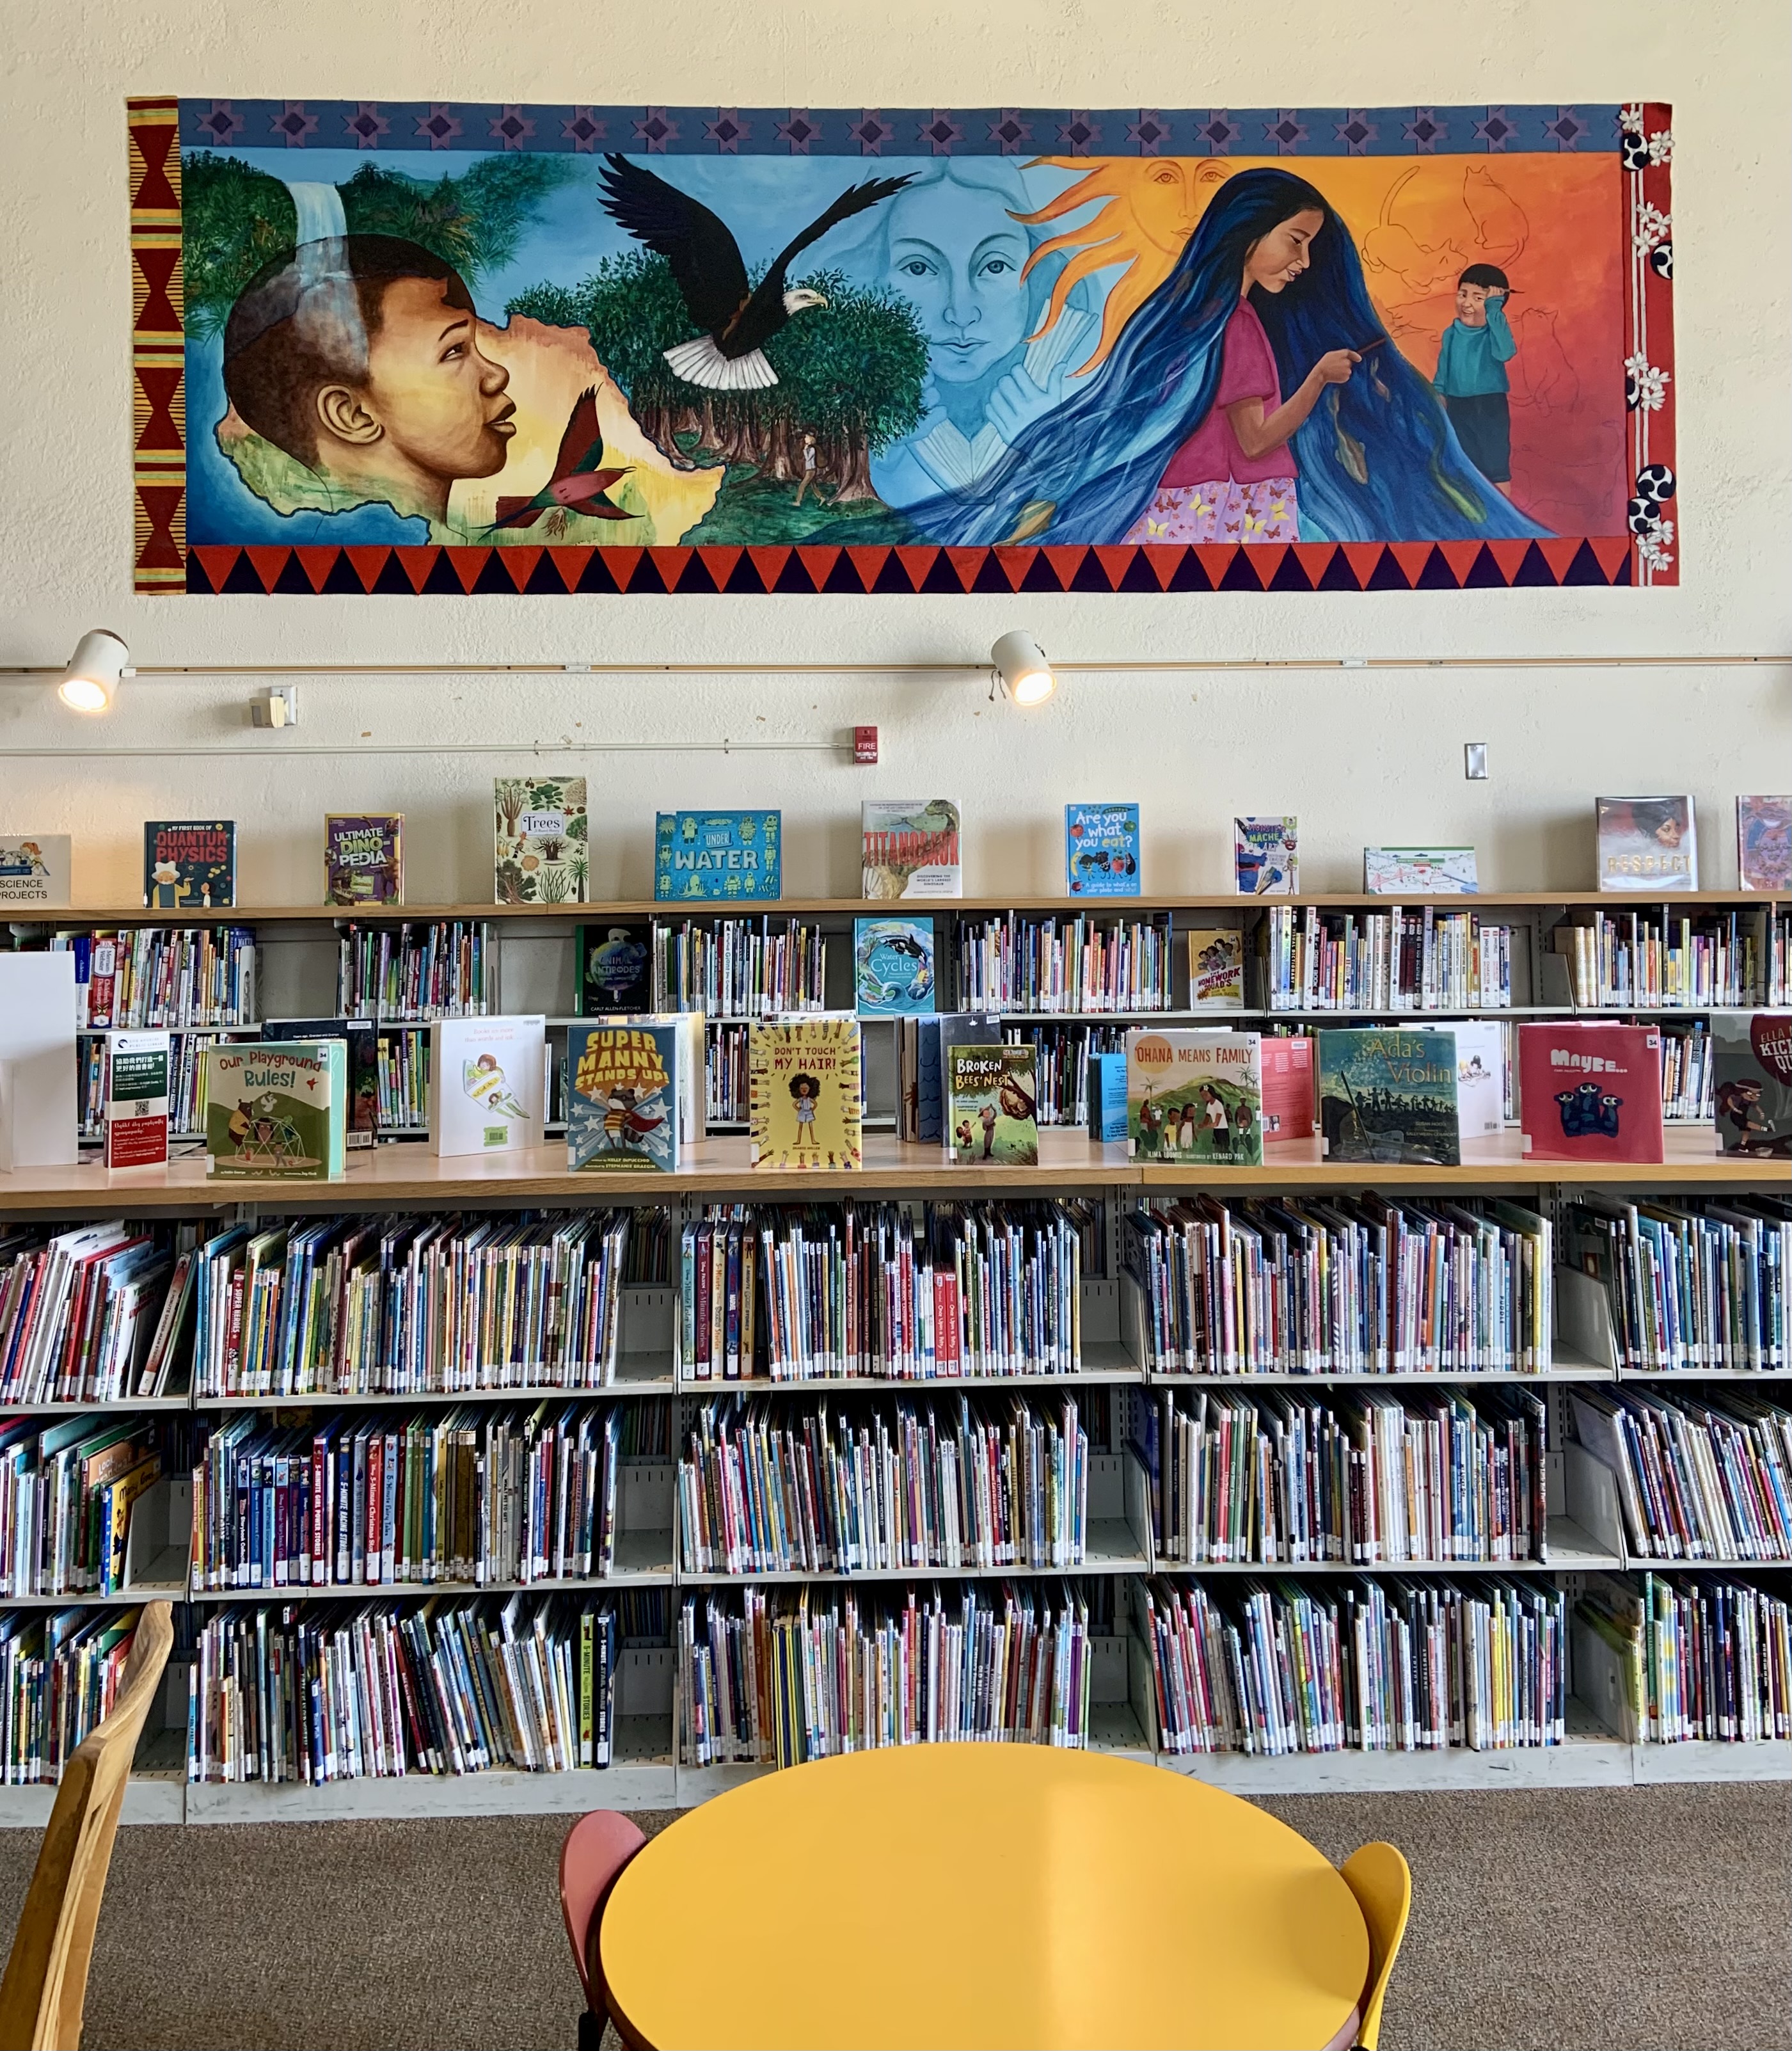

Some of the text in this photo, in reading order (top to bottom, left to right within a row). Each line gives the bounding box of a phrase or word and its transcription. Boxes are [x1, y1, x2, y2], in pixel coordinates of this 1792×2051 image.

[523, 816, 560, 831] Trees
[1076, 811, 1127, 827] Are you
[334, 827, 384, 842] ULTIMATE
[1088, 822, 1122, 837] what
[157, 831, 228, 846] QUANTUM
[340, 837, 390, 855] DINO-
[706, 832, 729, 845] UNDER
[1075, 834, 1133, 851] you eat?
[155, 847, 228, 863] PHYSICS
[864, 831, 959, 866] TITANOSAUR
[1263, 843, 1276, 852] ART
[339, 850, 387, 866] PEDIA
[675, 850, 758, 870] WATER
[0, 879, 43, 888] SCIENCE
[0, 891, 47, 899] ROJECTS
[593, 965, 640, 974] ANTIPODES
[865, 957, 917, 977] Cycles
[1198, 968, 1240, 987] HOMEWORK
[1204, 979, 1232, 991] SQUAD'S
[587, 1030, 656, 1052] SUPER
[1761, 1028, 1785, 1043] ELLA
[1369, 1034, 1425, 1058] Ada's
[220, 1051, 322, 1073] Our Playground
[577, 1050, 663, 1074] MANNY
[774, 1058, 836, 1070] MY HAIR!
[1178, 1049, 1210, 1063] MEANS
[1216, 1048, 1253, 1064] FAMILY
[957, 1058, 1002, 1074] BROKEN
[1386, 1061, 1451, 1084] Violin
[244, 1069, 296, 1088] Rules!
[575, 1069, 669, 1089] STANDS UP!
[956, 1074, 1010, 1090] BEES' NEST
[1164, 1151, 1182, 1160] LOOMIS
[233, 1289, 243, 1332] SUPER HEROES
[340, 1481, 348, 1509] 5-MINUTE
[385, 1505, 393, 1520] Fairy
[340, 1510, 348, 1532] RACING
